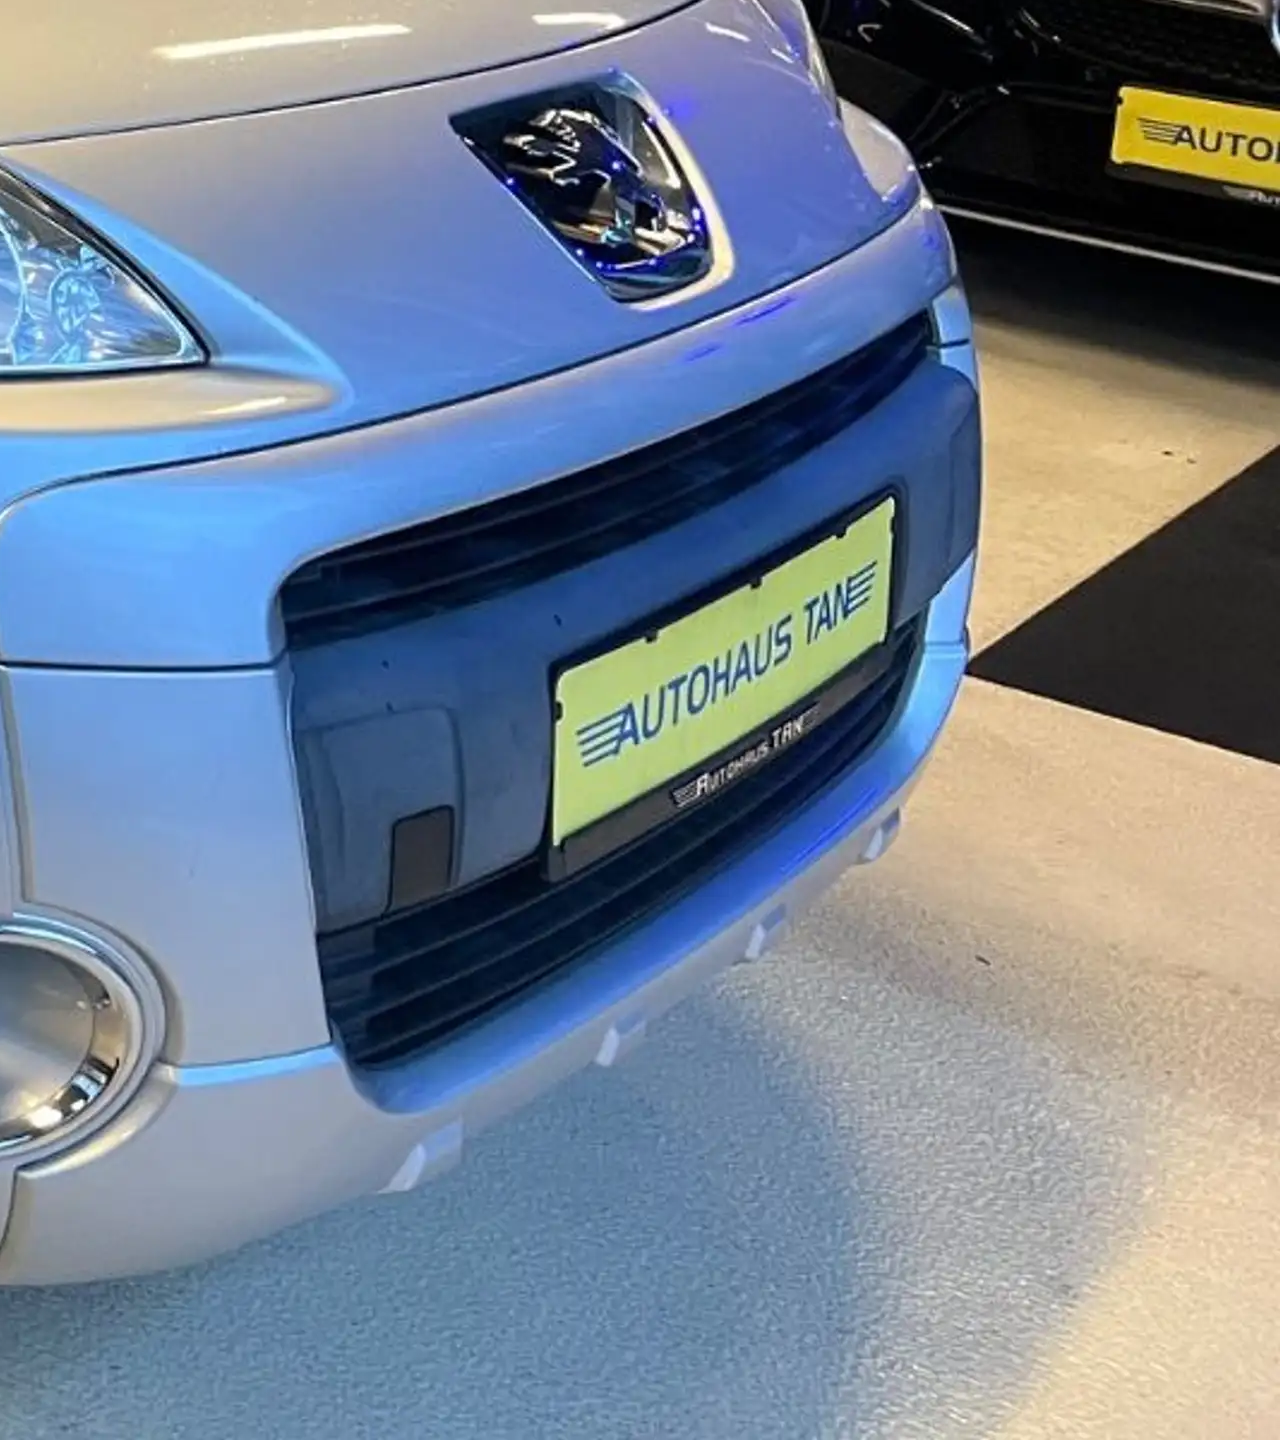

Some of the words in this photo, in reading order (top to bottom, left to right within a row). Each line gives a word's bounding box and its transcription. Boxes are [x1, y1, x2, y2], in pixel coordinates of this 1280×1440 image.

[1172, 124, 1280, 164] AUTO
[614, 613, 792, 754] AUTOHAUS
[803, 578, 852, 645] TAN
[771, 715, 805, 749] TAN
